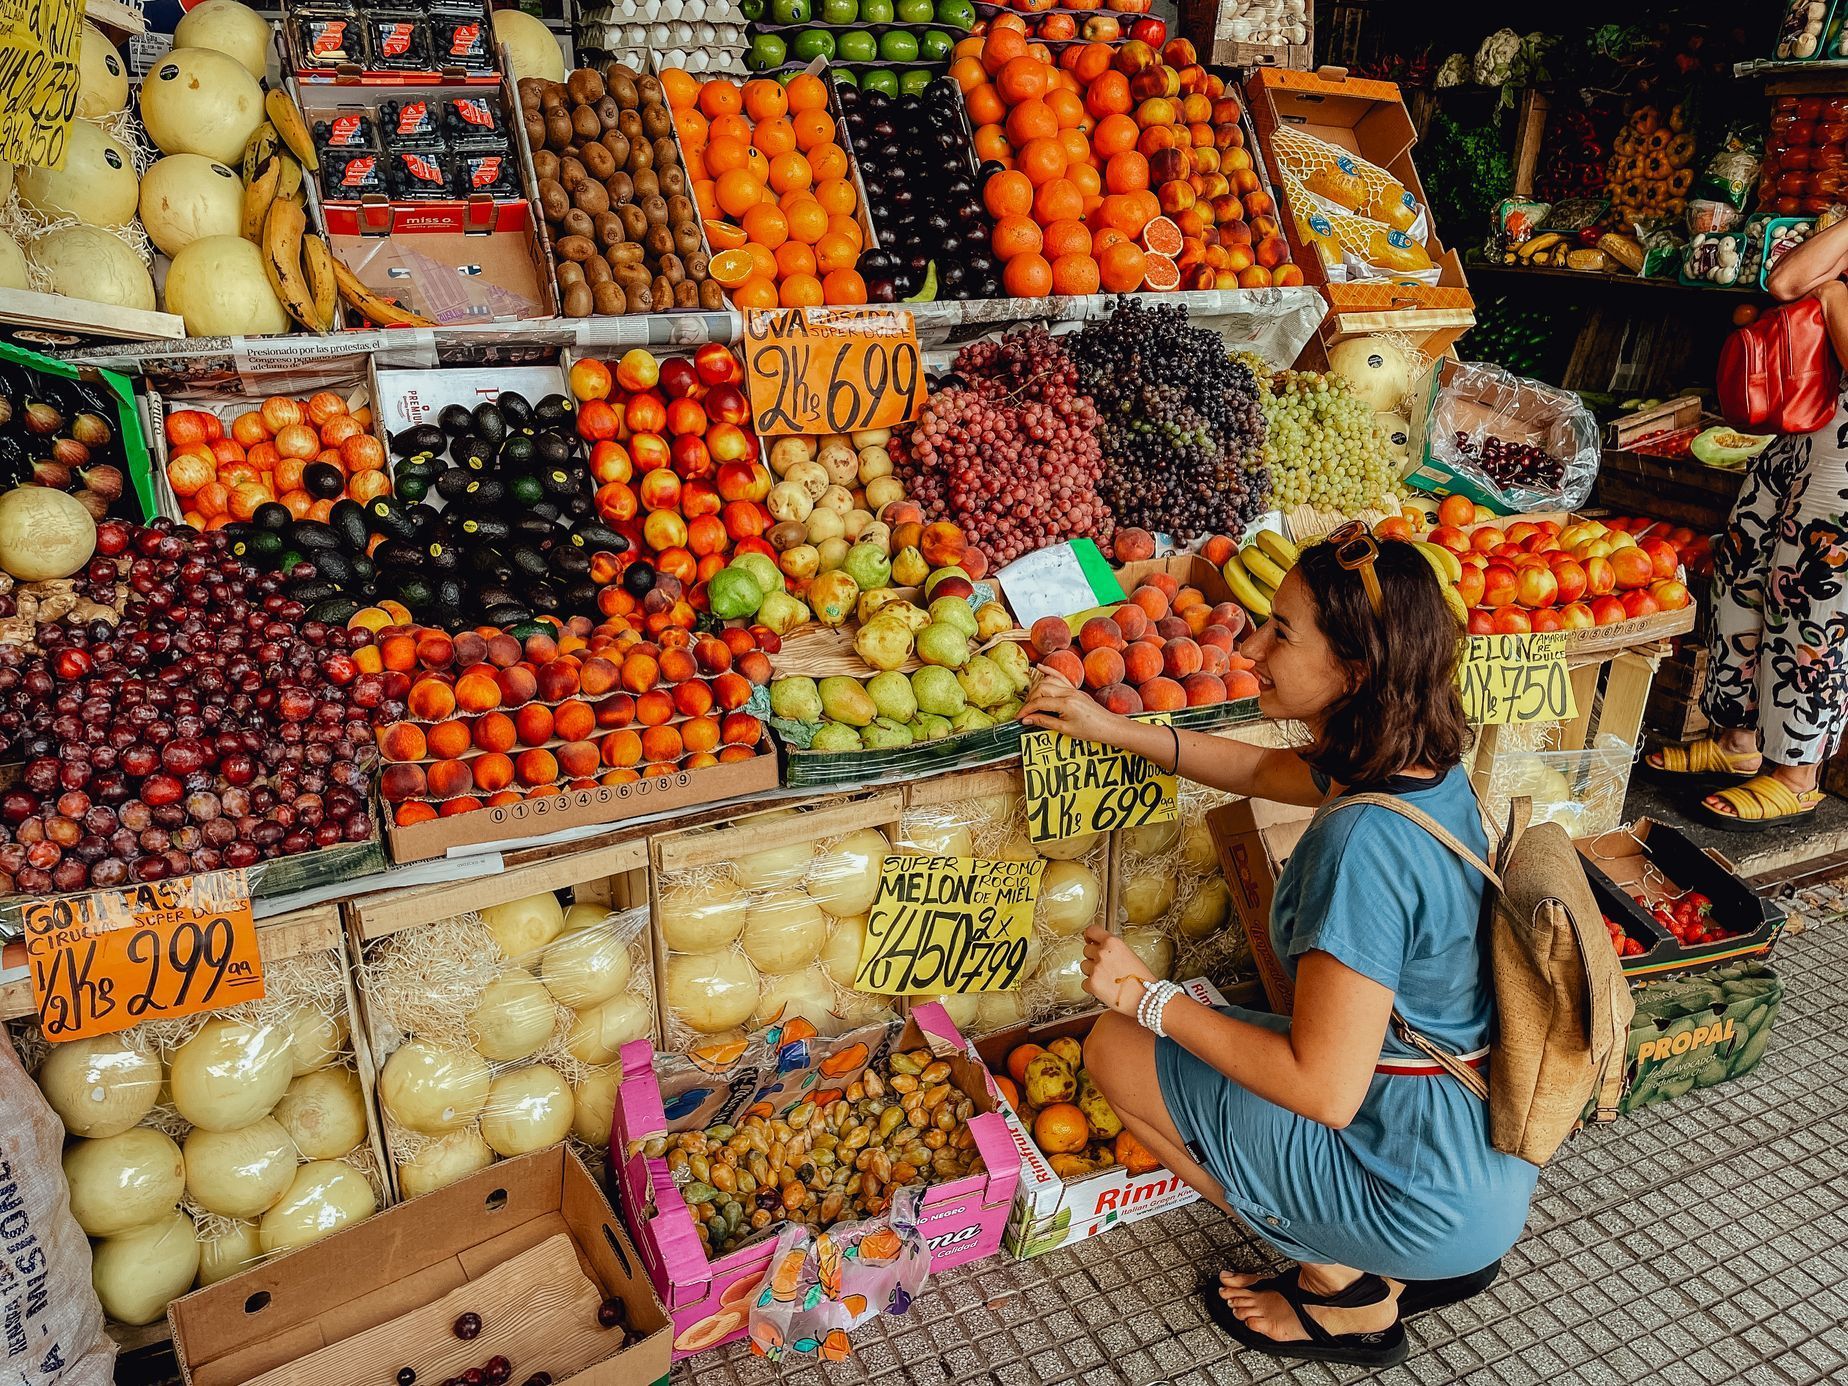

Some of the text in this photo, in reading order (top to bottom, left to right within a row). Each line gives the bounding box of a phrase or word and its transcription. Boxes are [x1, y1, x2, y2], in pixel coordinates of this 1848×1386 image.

[406, 216, 439, 225] miss
[747, 309, 809, 341] UVA
[809, 327, 911, 339] SUPER DULCE
[246, 340, 380, 357] Presionado por las protestas, el
[248, 355, 292, 364] Congreso
[826, 343, 918, 433] 699
[1467, 634, 1538, 663] ELON
[1532, 650, 1566, 662] DULCE
[1537, 643, 1551, 653] RE
[1500, 662, 1567, 723] 750
[1025, 754, 1147, 801] DURAZNO
[1091, 782, 1163, 831] 699
[882, 856, 1042, 876] SUPER PROMO
[872, 872, 1029, 906] MELON ROCIO
[974, 885, 1035, 906] DE MIEL
[25, 880, 182, 936] GOTITAS
[27, 899, 248, 956] CIRUELAS SUPER DULCES
[972, 906, 997, 941] 2
[881, 909, 974, 992] 450
[957, 936, 1028, 993] 799
[127, 918, 235, 1016] 299
[228, 960, 253, 976] 99
[1638, 1017, 1737, 1066] PROPAL
[1674, 1053, 1718, 1076] AVOCADOS
[930, 1206, 966, 1221] NEGRO
[1120, 1203, 1148, 1216] Italian
[1149, 1194, 1174, 1208] Green
[937, 1240, 979, 1258] Calidad
